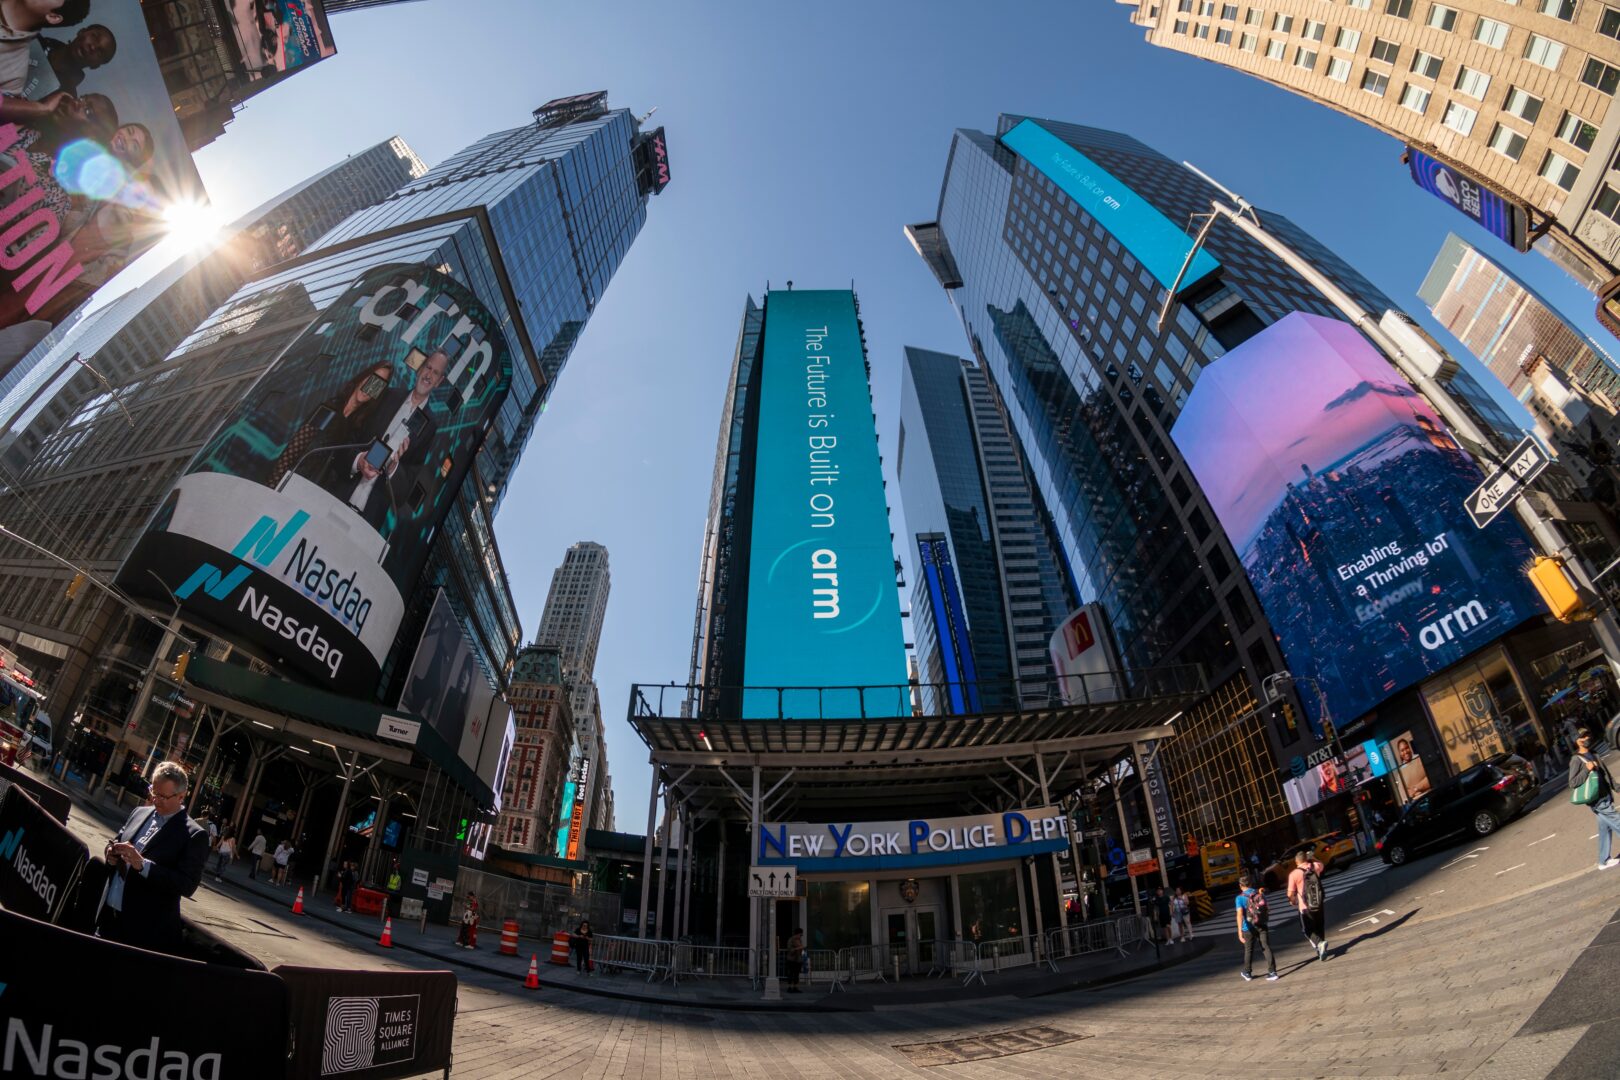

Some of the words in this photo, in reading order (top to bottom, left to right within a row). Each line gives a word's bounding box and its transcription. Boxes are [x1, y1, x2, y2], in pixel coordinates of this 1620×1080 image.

[290, 11, 310, 57] TURISMO
[298, 17, 312, 47] GRAN
[1103, 195, 1121, 210] arm
[1460, 180, 1472, 212] TACO
[1470, 187, 1481, 218] BELL
[359, 278, 494, 405] arm
[805, 325, 829, 351] The
[806, 355, 831, 408] Future
[808, 413, 836, 429] is
[808, 435, 840, 486] Built
[809, 493, 836, 528] on
[1480, 484, 1504, 509] ONE
[1336, 540, 1402, 582] Enabling
[1355, 584, 1368, 597] a
[1364, 549, 1430, 590] Thriving
[1424, 532, 1449, 556] IoT
[283, 537, 374, 639] Nasdaq
[811, 548, 841, 619] arm
[1354, 577, 1424, 622] Economy
[237, 586, 344, 679] Nasdaq
[1418, 599, 1489, 650] arm
[388, 725, 409, 736] Turner
[578, 759, 590, 784] Locker
[1306, 743, 1335, 769] AT&T
[576, 785, 586, 801] Foot
[760, 824, 825, 858] NEW
[827, 823, 903, 858] YORK
[908, 820, 997, 854] POLICE
[1002, 812, 1068, 845] DEPT
[1155, 806, 1171, 844] TIMES
[1164, 850, 1174, 858] 3
[13, 844, 58, 915] Nasdaq
[379, 1023, 413, 1040] SQUARE
[384, 1009, 412, 1023] TIMES
[380, 1037, 410, 1052] ALLIANCE
